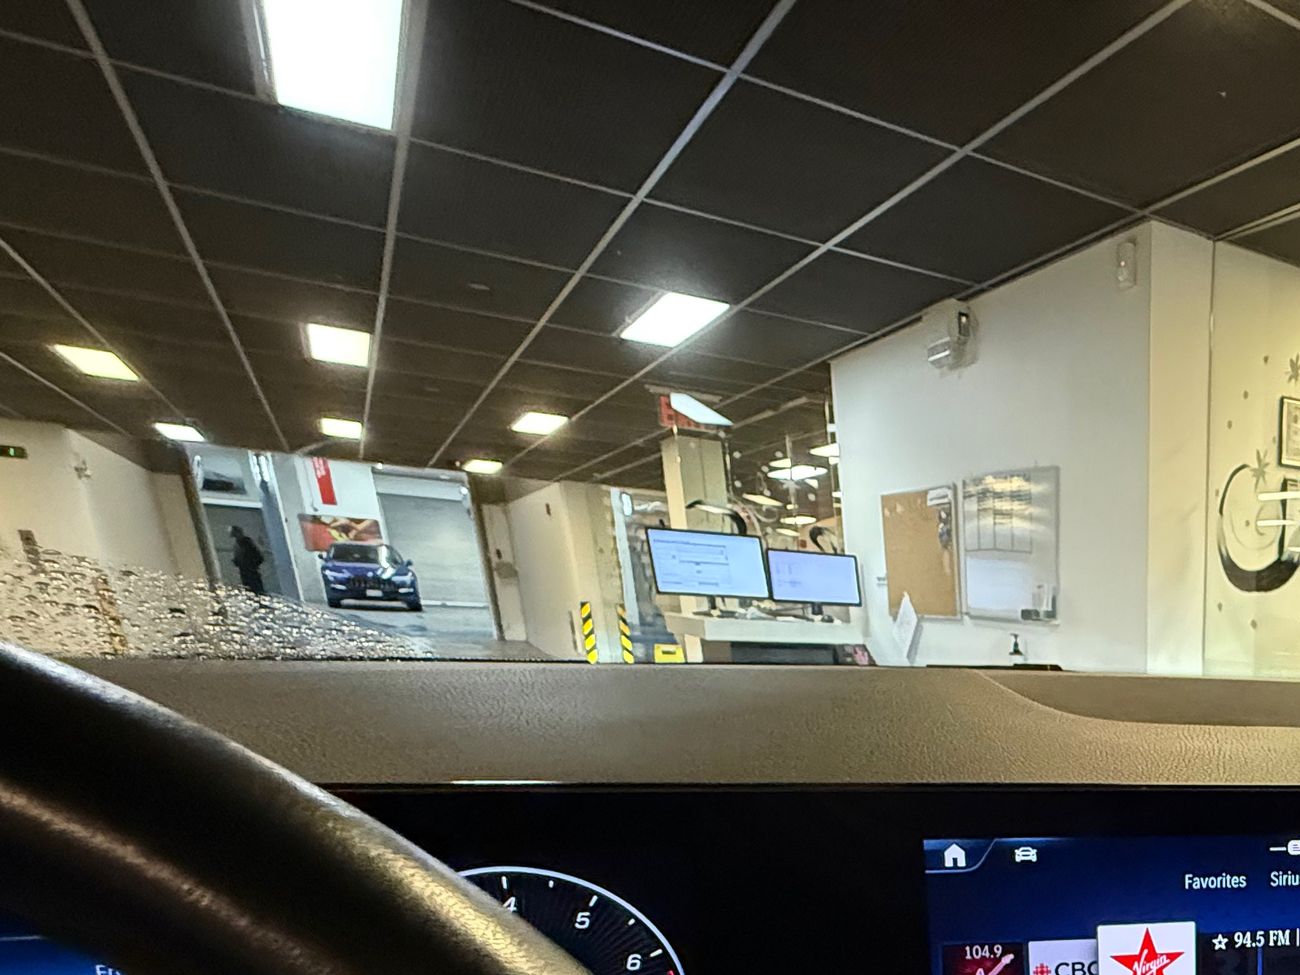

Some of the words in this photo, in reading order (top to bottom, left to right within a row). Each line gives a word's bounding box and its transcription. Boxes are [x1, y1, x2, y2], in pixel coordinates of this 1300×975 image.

[1184, 873, 1247, 889] Favorites
[574, 911, 591, 929] 5
[1234, 930, 1265, 948] 94.5
[1268, 929, 1290, 946] FM
[965, 944, 1003, 959] 104.9
[626, 953, 642, 971] 6
